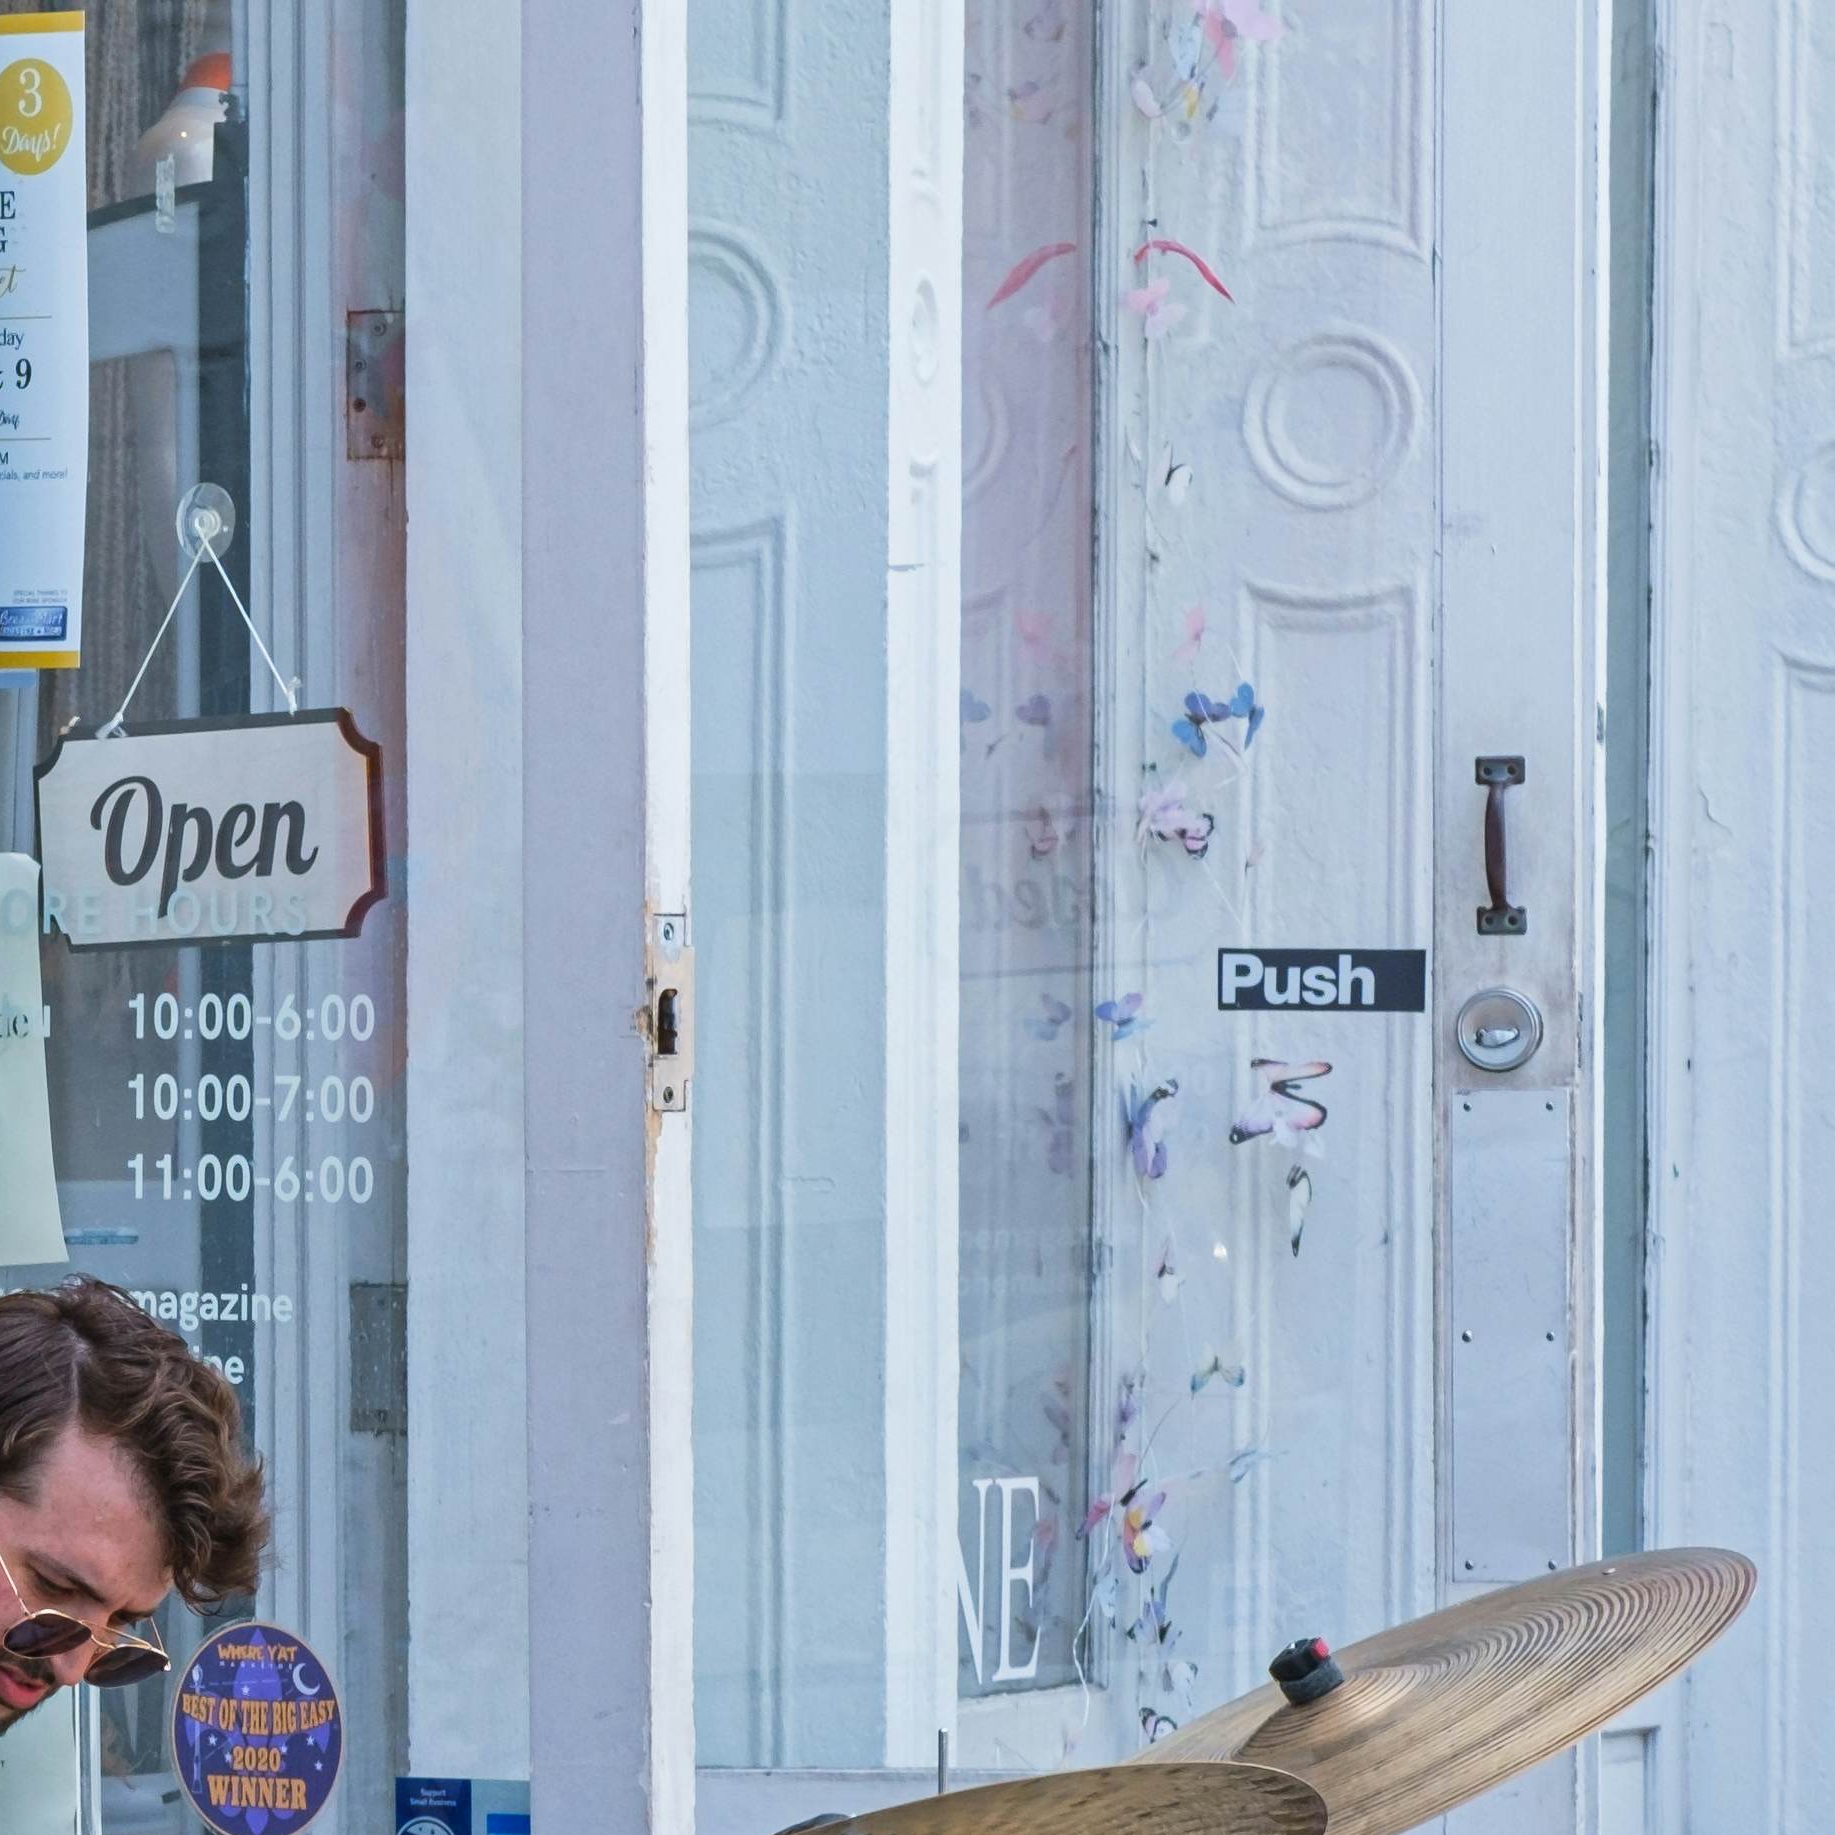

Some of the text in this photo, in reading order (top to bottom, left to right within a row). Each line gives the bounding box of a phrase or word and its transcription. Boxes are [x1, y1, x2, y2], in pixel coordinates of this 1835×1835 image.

[18, 67, 42, 117] 3
[0, 122, 62, 162] Days!
[16, 358, 32, 389] 9
[23, 468, 40, 480] and
[90, 775, 319, 919] Open
[130, 885, 307, 935] HOURS
[1221, 953, 1375, 1007] Push
[129, 993, 376, 1041] 10:00-6:00
[129, 1074, 375, 1122] 10:00-7:00
[129, 1154, 374, 1203] 11:00-6:00
[183, 1693, 335, 1735] BEST OF THE BIG EASY
[233, 1745, 281, 1772] 2020
[207, 1774, 307, 1810] WINNER
